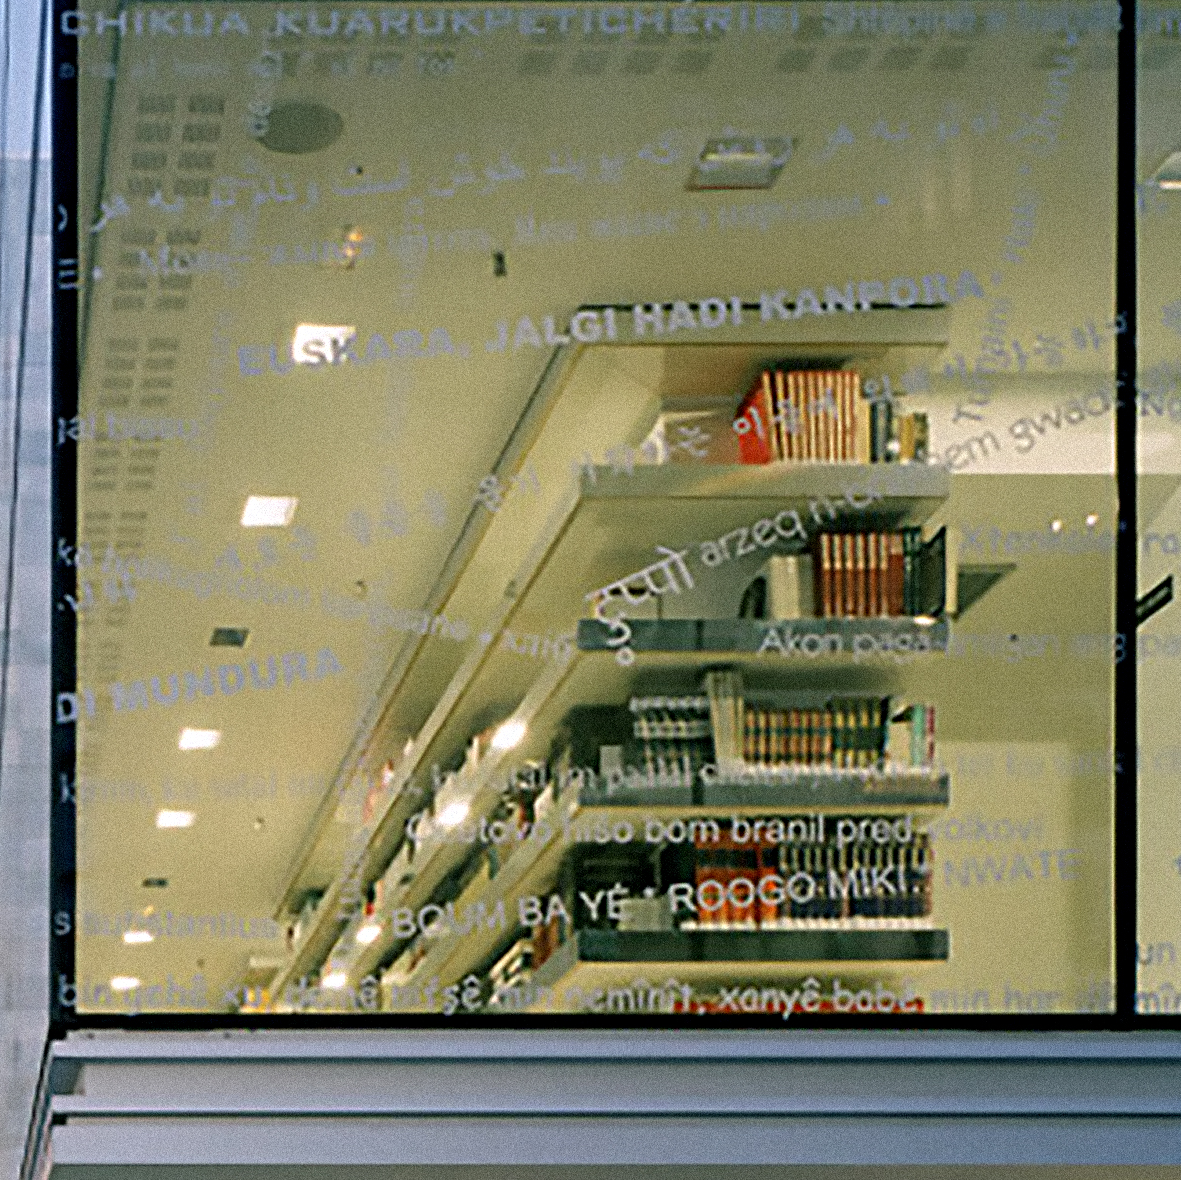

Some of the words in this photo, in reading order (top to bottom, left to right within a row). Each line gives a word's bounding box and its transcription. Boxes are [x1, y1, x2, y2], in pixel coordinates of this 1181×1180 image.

[235, 328, 470, 379] EUSKARA,
[485, 304, 613, 352] JALGI
[632, 297, 741, 341] HADI
[758, 271, 983, 324] KANPORA
[756, 629, 844, 655] Akon
[111, 648, 341, 704] MUNDURA
[644, 812, 719, 842] bom
[731, 812, 824, 842] branil
[835, 814, 913, 848] pred
[517, 894, 571, 928] BA
[668, 874, 815, 914] ROOGO
